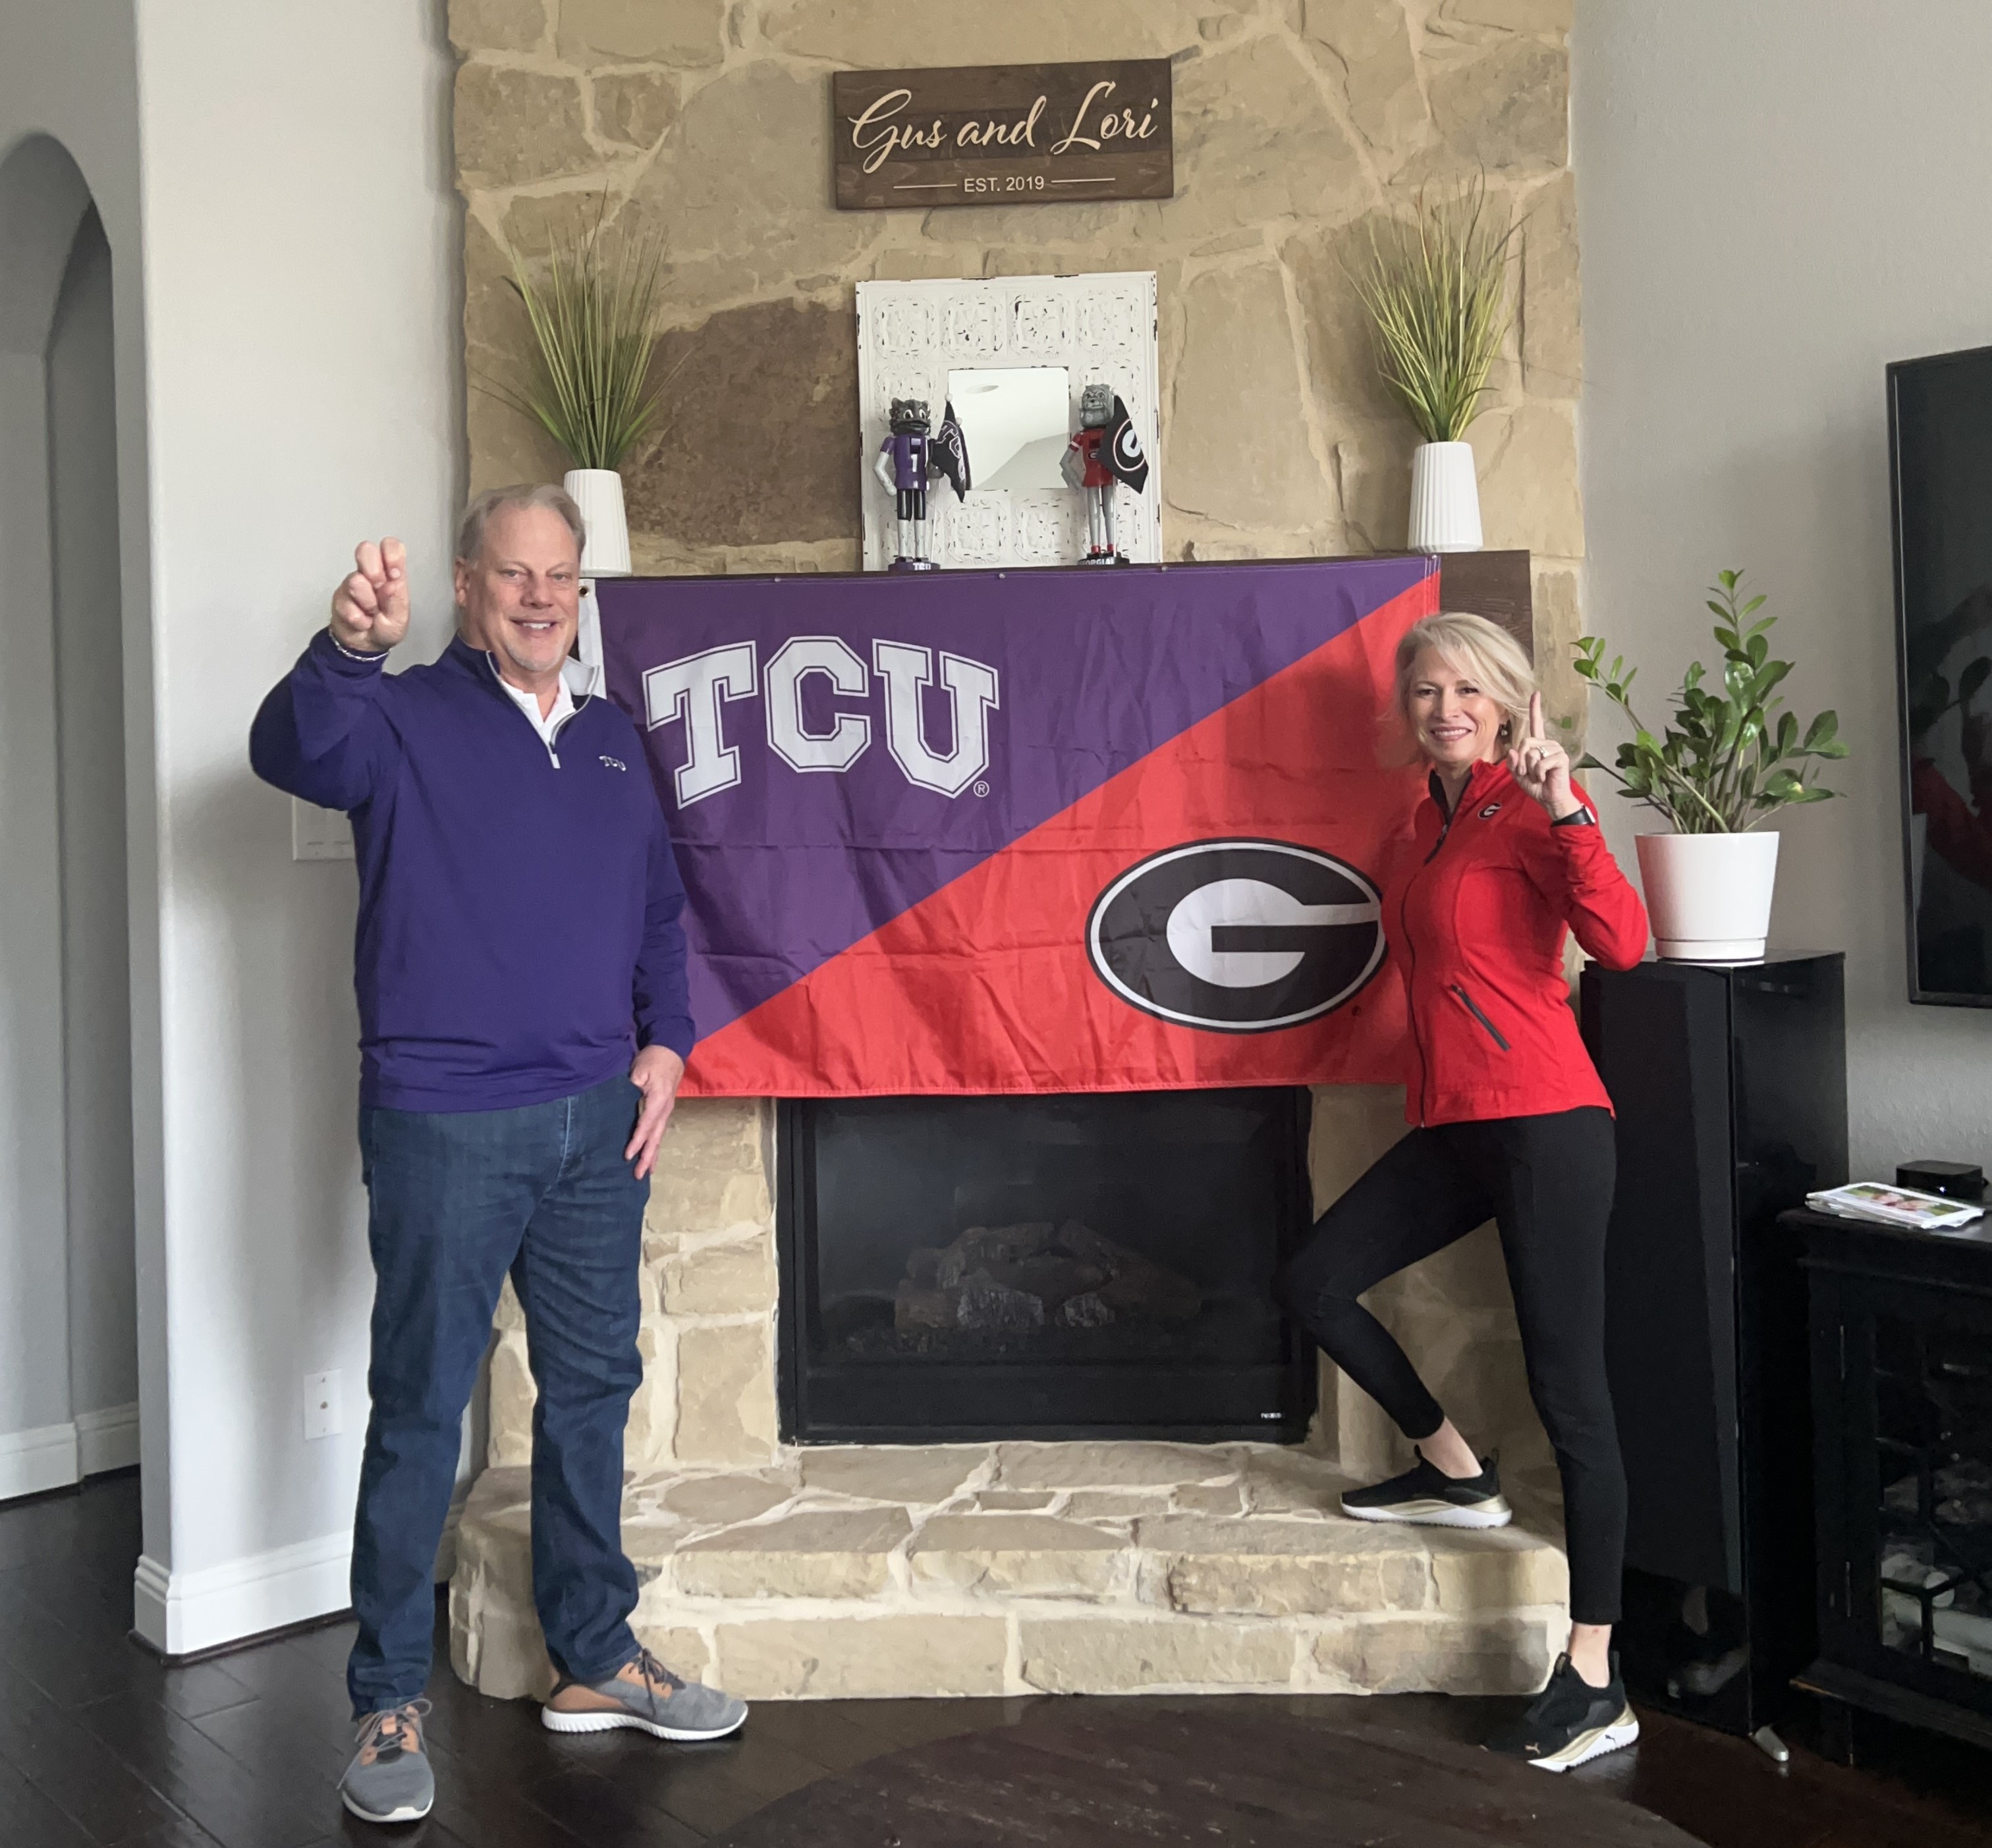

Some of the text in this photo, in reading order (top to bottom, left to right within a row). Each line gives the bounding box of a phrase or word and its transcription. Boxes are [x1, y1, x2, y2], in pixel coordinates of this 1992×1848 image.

[848, 80, 1159, 174] Gus and Lori
[964, 175, 1045, 193] EST. 2019
[910, 454, 918, 473] 1
[642, 635, 1000, 810] TCU
[598, 755, 626, 771] TCU
